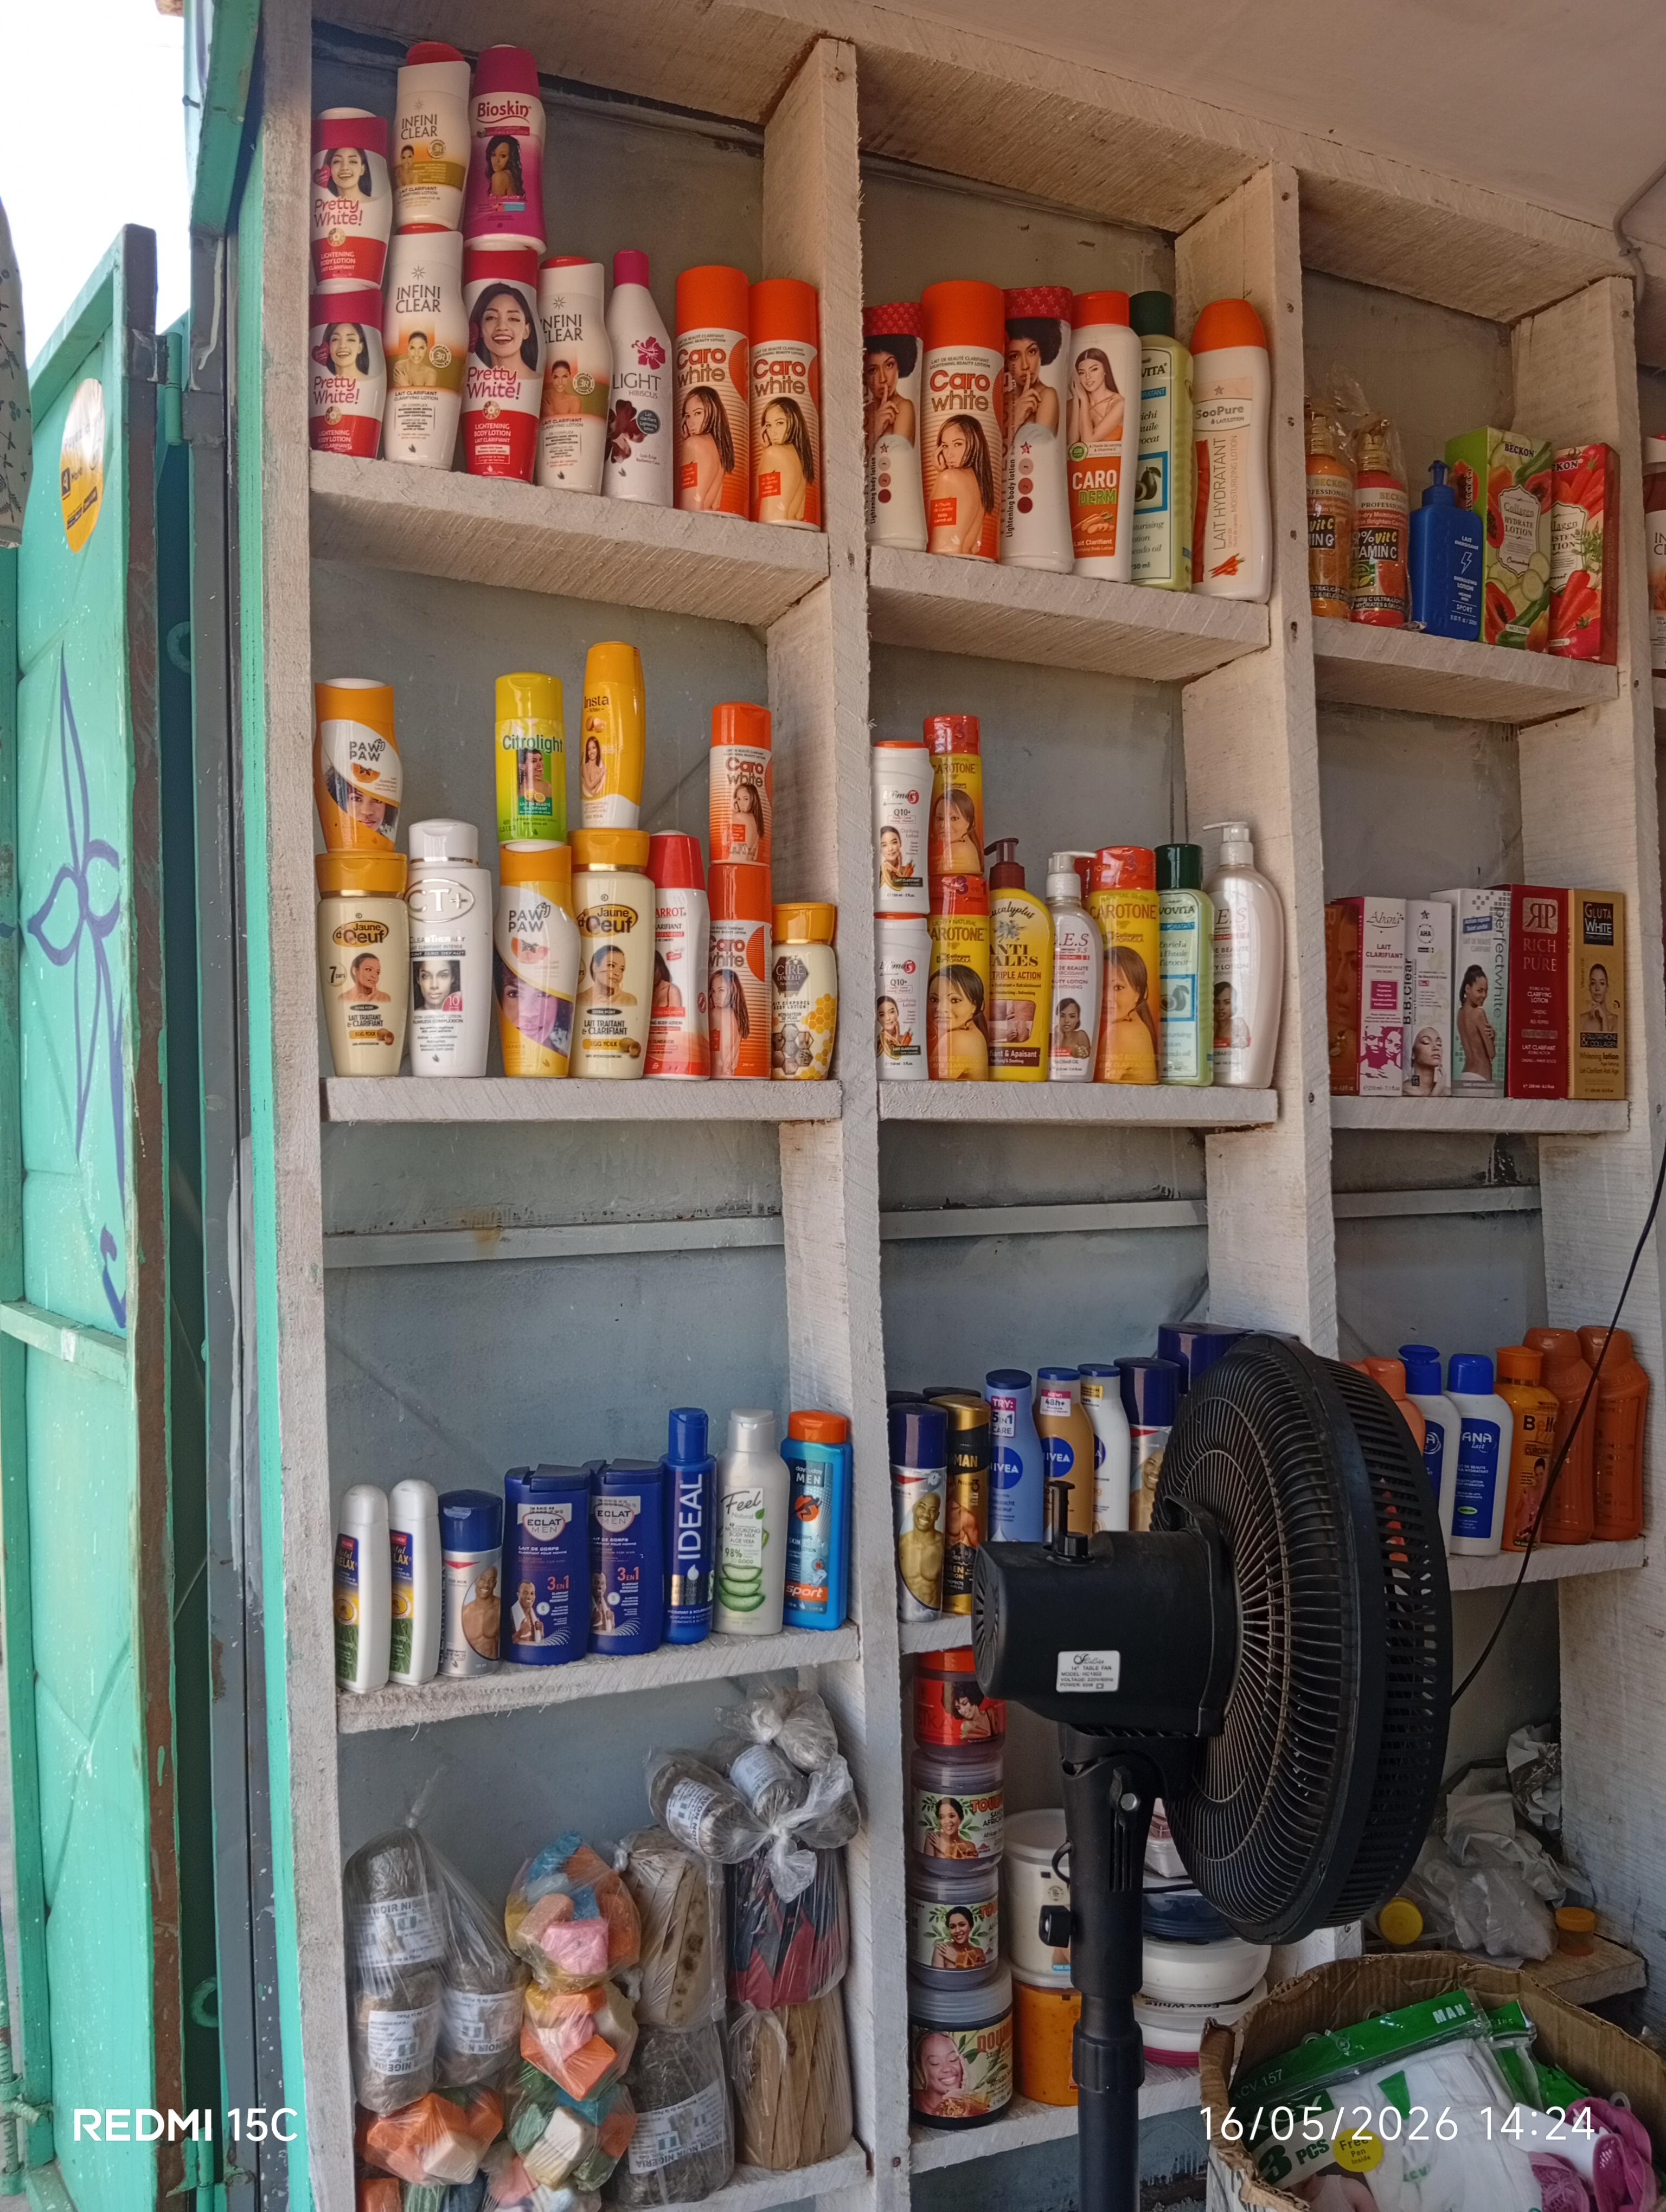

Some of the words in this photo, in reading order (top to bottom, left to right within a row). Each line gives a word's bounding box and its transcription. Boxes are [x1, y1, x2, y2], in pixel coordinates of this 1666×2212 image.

[477, 101, 529, 117] Bioskin
[401, 114, 438, 129] INFINI
[401, 126, 438, 140] CLEAR
[315, 198, 359, 213] Pretty
[314, 210, 363, 227] White!
[397, 285, 440, 300] INFINI
[396, 299, 441, 313] CLEAR
[676, 348, 726, 370] Caro
[467, 367, 516, 383] Pretty
[678, 364, 725, 388] white
[753, 359, 806, 379] Caro
[314, 376, 356, 390] Pretty
[613, 373, 662, 391] LIGHT
[755, 376, 805, 397] white
[930, 370, 990, 392] Caro
[313, 388, 360, 405] White!
[466, 383, 522, 400] White!
[629, 390, 658, 399] HIBISCUS
[932, 389, 989, 411] white
[1195, 406, 1244, 420] SooPure
[1504, 443, 1535, 458] BECKON
[1073, 470, 1117, 490] CARO
[1213, 438, 1226, 516] HYDRATANT
[1007, 480, 1015, 495] body
[1079, 488, 1116, 505] DERM
[1006, 497, 1014, 537] Lightening
[1504, 502, 1534, 517] Collagen
[1505, 517, 1533, 529] HYDRATE
[1213, 518, 1226, 550] LAIT
[1505, 525, 1533, 537] LOTION
[1457, 583, 1473, 591] LOTION
[1456, 603, 1472, 613] SPORT
[584, 695, 609, 709] Insta
[349, 742, 380, 753] PAW
[503, 735, 562, 754] Citrolight
[349, 751, 380, 762] PAW
[725, 757, 764, 776] Caro
[727, 771, 764, 788] white
[509, 909, 542, 921] PAW
[597, 908, 629, 918] Jaune
[1091, 904, 1157, 919] CAROTONE
[1585, 903, 1612, 919] GLUTA
[508, 921, 543, 933] PAW
[1585, 918, 1612, 933] WHITE
[1523, 938, 1556, 953] RICH
[776, 965, 804, 975] CIRE
[1493, 907, 1505, 1018] perfectwhite
[1523, 958, 1557, 972] PURE
[329, 966, 337, 983] 7
[1404, 959, 1413, 1025] B.B.Clear
[449, 996, 460, 1006] 10
[1010, 1050, 1036, 1058] Apaisant
[992, 1398, 1014, 1408] TRY:
[992, 1426, 1012, 1434] CARE
[954, 1454, 978, 1467] MAN
[796, 1473, 821, 1485] MEN
[721, 1491, 761, 1514] Feel
[598, 1509, 631, 1518] ECLAT
[601, 1517, 626, 1525] MEN
[677, 1474, 702, 1559] IDEAL
[527, 1518, 562, 1526] ECLAT
[531, 1525, 558, 1533] MEN
[725, 1548, 742, 1558] 98%
[786, 1585, 823, 1598] sport
[1432, 2004, 1465, 2024] MAN
[1350, 2148, 1366, 2156] Pen
[1351, 2155, 1370, 2164] Inside
[1258, 2144, 1292, 2185] 3
[1295, 2138, 1329, 2164] PCS
